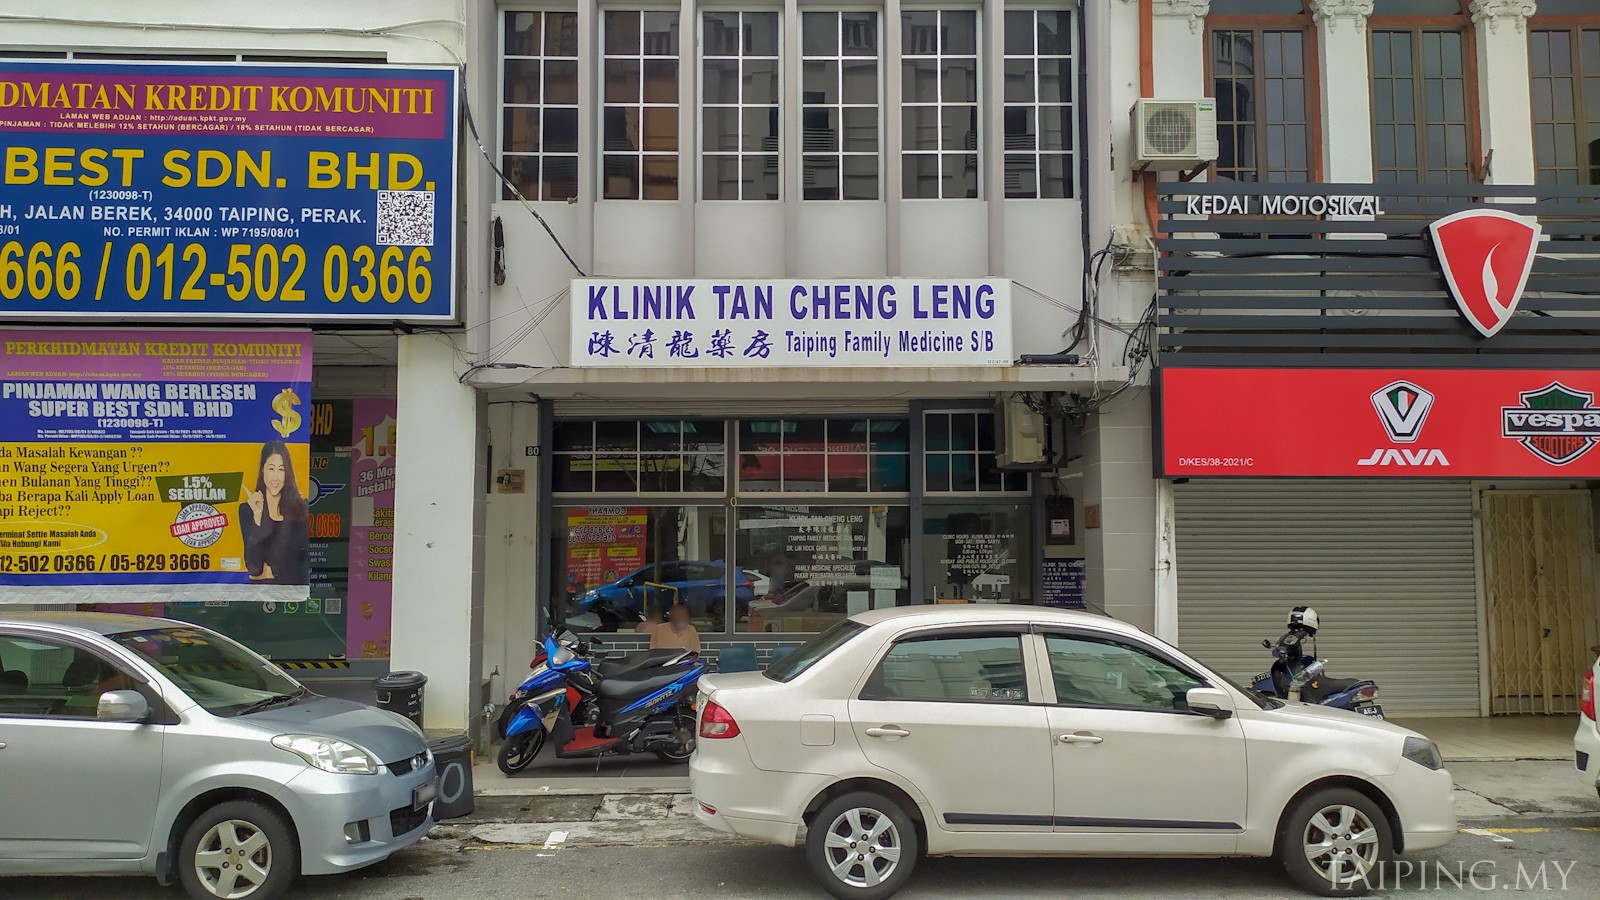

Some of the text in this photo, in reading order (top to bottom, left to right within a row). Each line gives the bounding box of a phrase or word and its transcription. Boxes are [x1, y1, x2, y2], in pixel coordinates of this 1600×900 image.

[144, 84, 263, 113] KREDIT
[269, 86, 434, 115] KOMUNITI
[150, 115, 247, 124] http://aduan.kpkt.gov.my
[137, 123, 175, 131] SETAHUN
[177, 123, 229, 132] (BERCAGAR)
[294, 125, 322, 133] (TIDAK
[325, 126, 375, 134] BERCAGAR)
[4, 146, 436, 190] BEST SDN. BHD.
[89, 190, 153, 201] (1230098-T)
[1187, 195, 1386, 215] KEDAI MOTOSIKAL
[24, 205, 85, 219] JALAN
[91, 206, 158, 223] BEREK,
[164, 206, 213, 221] 34000
[219, 207, 294, 225] TAIPING,
[301, 208, 367, 224] PERAK.
[103, 226, 300, 239] NO. PERMIT IKLAN WP 7195/08/01
[0, 241, 433, 304] 666 / 012-502 0366
[587, 284, 995, 320] KLINIK TAN CHENG LENG
[5, 341, 302, 357] PERKHIDMATAN KREDIT KOMUNITI
[785, 330, 994, 358] Taiping Family Medicine S/B
[3, 382, 256, 400] PINJAMAN WANG BERLESEN
[28, 400, 234, 418] SUPER BEST SDN. BHD
[1508, 413, 1600, 432] vespa
[16, 446, 66, 458] Masalah
[69, 447, 127, 461] Kewangan
[130, 447, 143, 458] ??
[527, 446, 539, 456] 80
[1532, 436, 1584, 458] SCOOTERS
[1178, 457, 1254, 467] D/KES/38-2021/C
[1356, 448, 1451, 466] JAVA
[13, 461, 170, 476] Wang Segera Yang Urgen??
[0, 475, 152, 491] en Bulanan Yang Tinggi??
[182, 476, 212, 491] 1.5%
[17, 490, 61, 504] Berapa
[65, 490, 88, 502] Kali
[91, 490, 123, 504] Apply
[127, 490, 155, 502] Loan
[168, 488, 226, 501] SEBULAN
[18, 504, 71, 519] Reject??
[179, 503, 215, 520] LOAN APPROVED
[847, 515, 864, 523] LENG
[173, 515, 226, 537] LOAN APPROVED
[316, 513, 341, 538] 0366
[49, 530, 79, 538] Masalah
[80, 530, 96, 538] Anda
[184, 537, 197, 547] LOAN
[12, 539, 42, 548] Hubungi
[43, 539, 61, 548] Kami
[53, 555, 96, 572] 0366
[99, 554, 106, 572] /
[110, 554, 166, 571] 05-829
[169, 553, 210, 571] 3666
